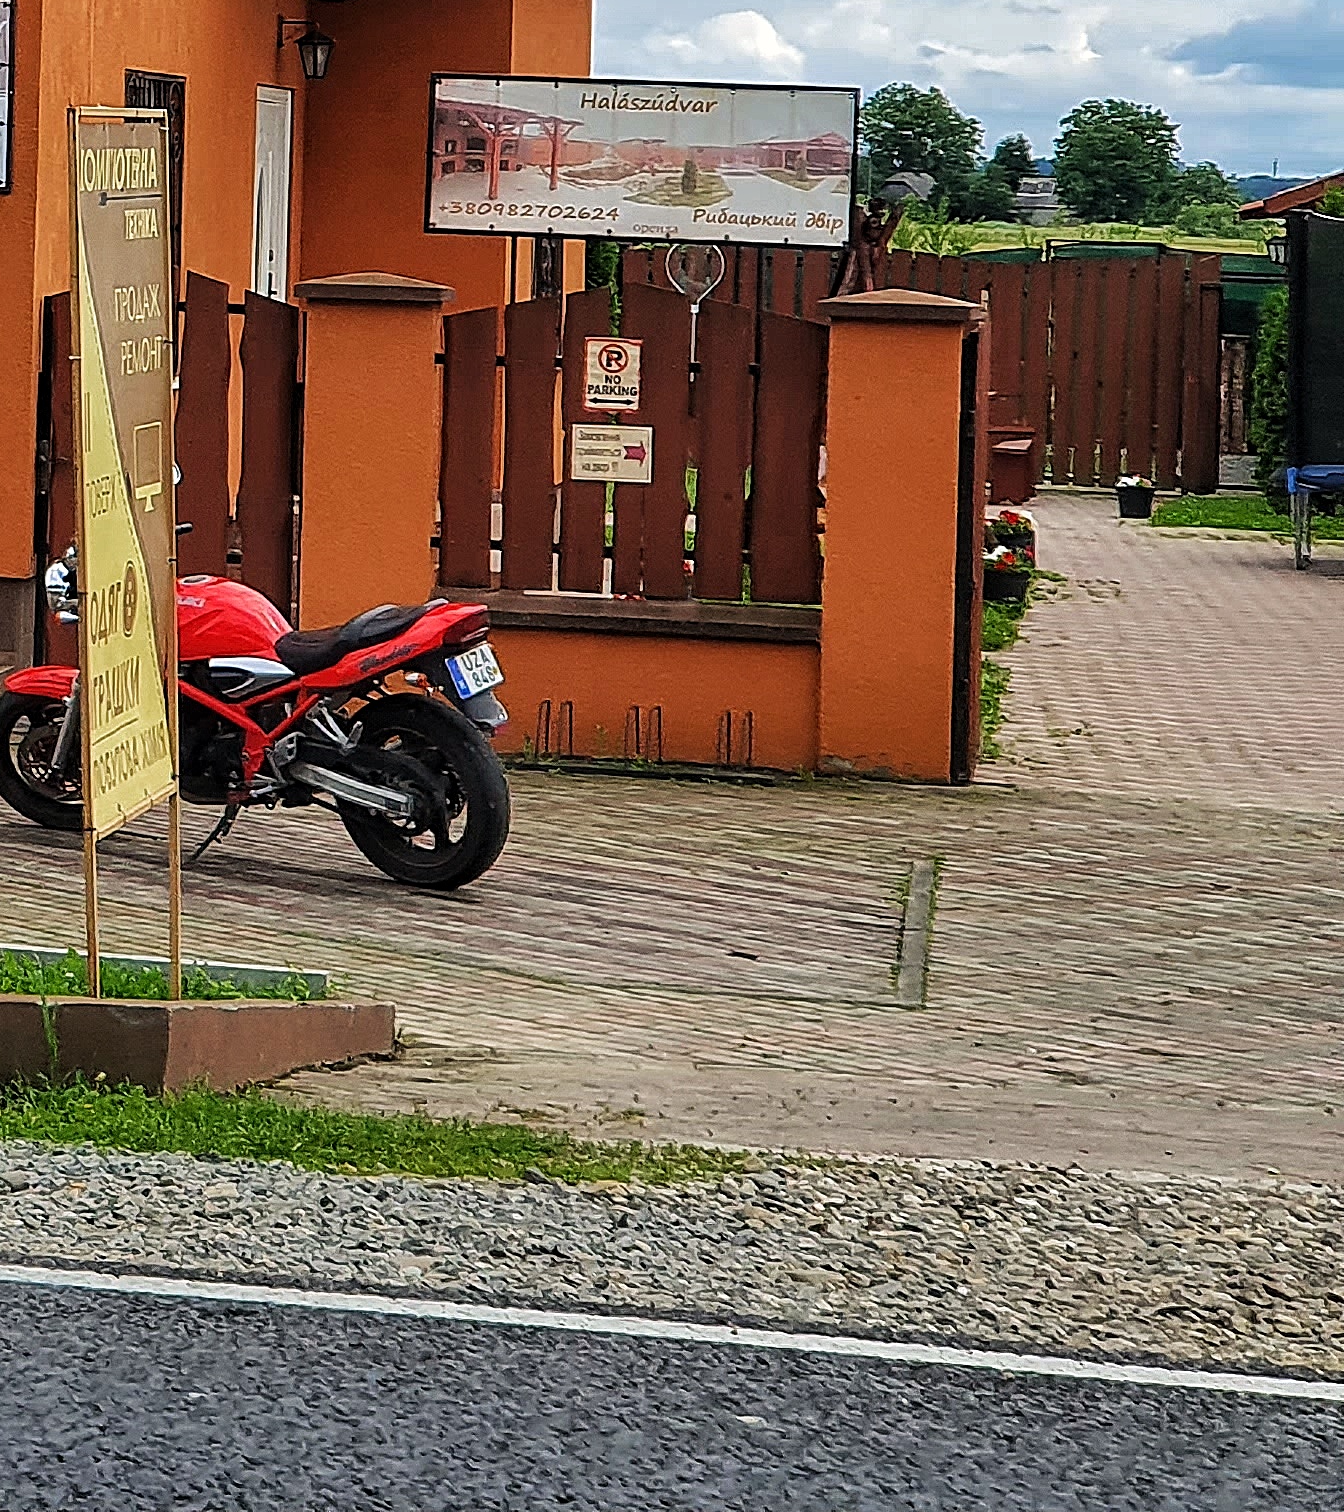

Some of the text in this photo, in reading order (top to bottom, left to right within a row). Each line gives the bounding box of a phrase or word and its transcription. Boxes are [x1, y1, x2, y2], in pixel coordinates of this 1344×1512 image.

[580, 91, 719, 114] Halászúdvar
[438, 201, 620, 222] +380982702624
[692, 208, 844, 235] Рибацький двір
[114, 283, 162, 324] ПРОДАЖ
[121, 335, 163, 376] РЕМОНТ
[587, 384, 638, 397] PARKING
[604, 374, 622, 385] NO
[90, 581, 122, 646] ОДЯГ
[460, 648, 491, 671] UZA
